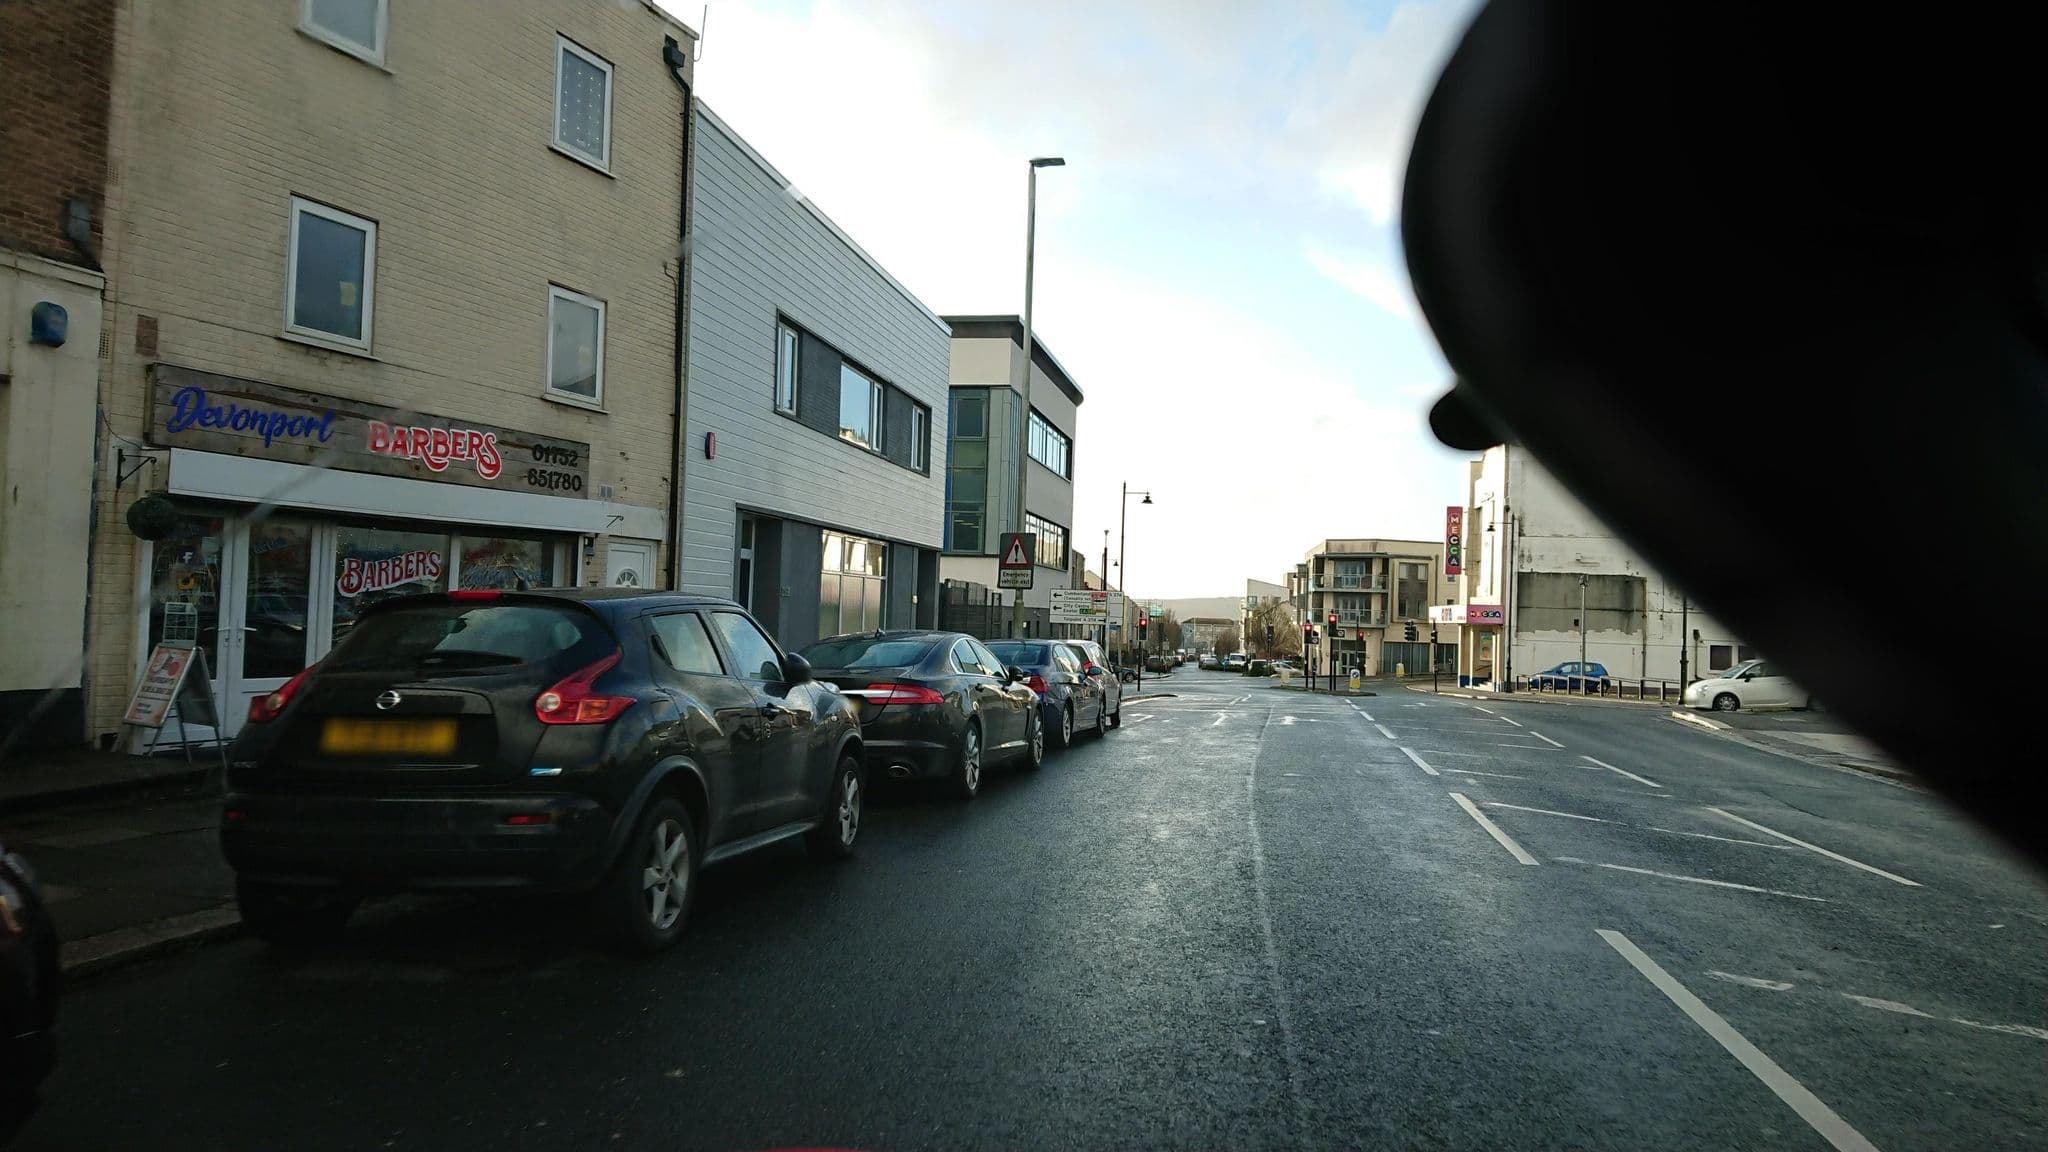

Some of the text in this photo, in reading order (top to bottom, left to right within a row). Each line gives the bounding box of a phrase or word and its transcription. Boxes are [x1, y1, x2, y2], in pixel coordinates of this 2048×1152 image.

[166, 386, 335, 448] Devonport
[368, 420, 502, 480] BARBERS
[527, 468, 582, 491] 651780
[1448, 515, 1460, 566] MECCA
[338, 549, 442, 597] BARBERS
[1469, 610, 1501, 618] MECCA
